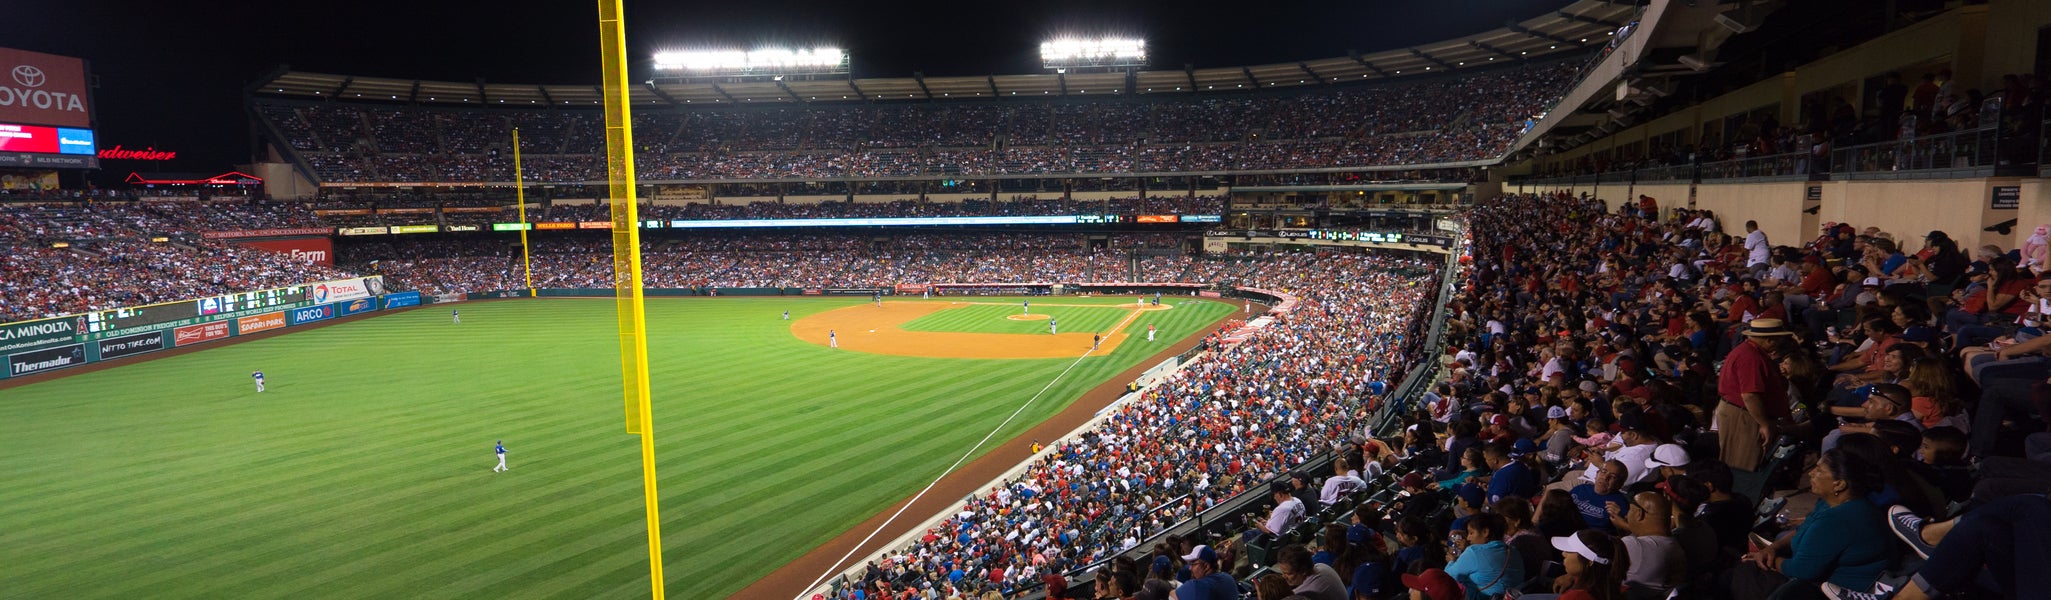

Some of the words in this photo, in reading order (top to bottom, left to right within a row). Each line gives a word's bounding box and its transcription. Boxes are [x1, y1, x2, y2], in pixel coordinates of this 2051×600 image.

[0, 86, 85, 112] OYOTA
[296, 307, 323, 321] ARCO
[17, 320, 72, 338] MINOLTA
[106, 330, 120, 338] OLD
[120, 324, 152, 335] DOMINION
[153, 321, 178, 330] FREIGHT
[178, 318, 191, 326] LINE
[241, 321, 265, 332] SAFARI
[266, 318, 284, 327] PARK
[102, 343, 126, 353] NITTO
[127, 336, 160, 348] TIRE.COM
[13, 355, 72, 374] Thermador
